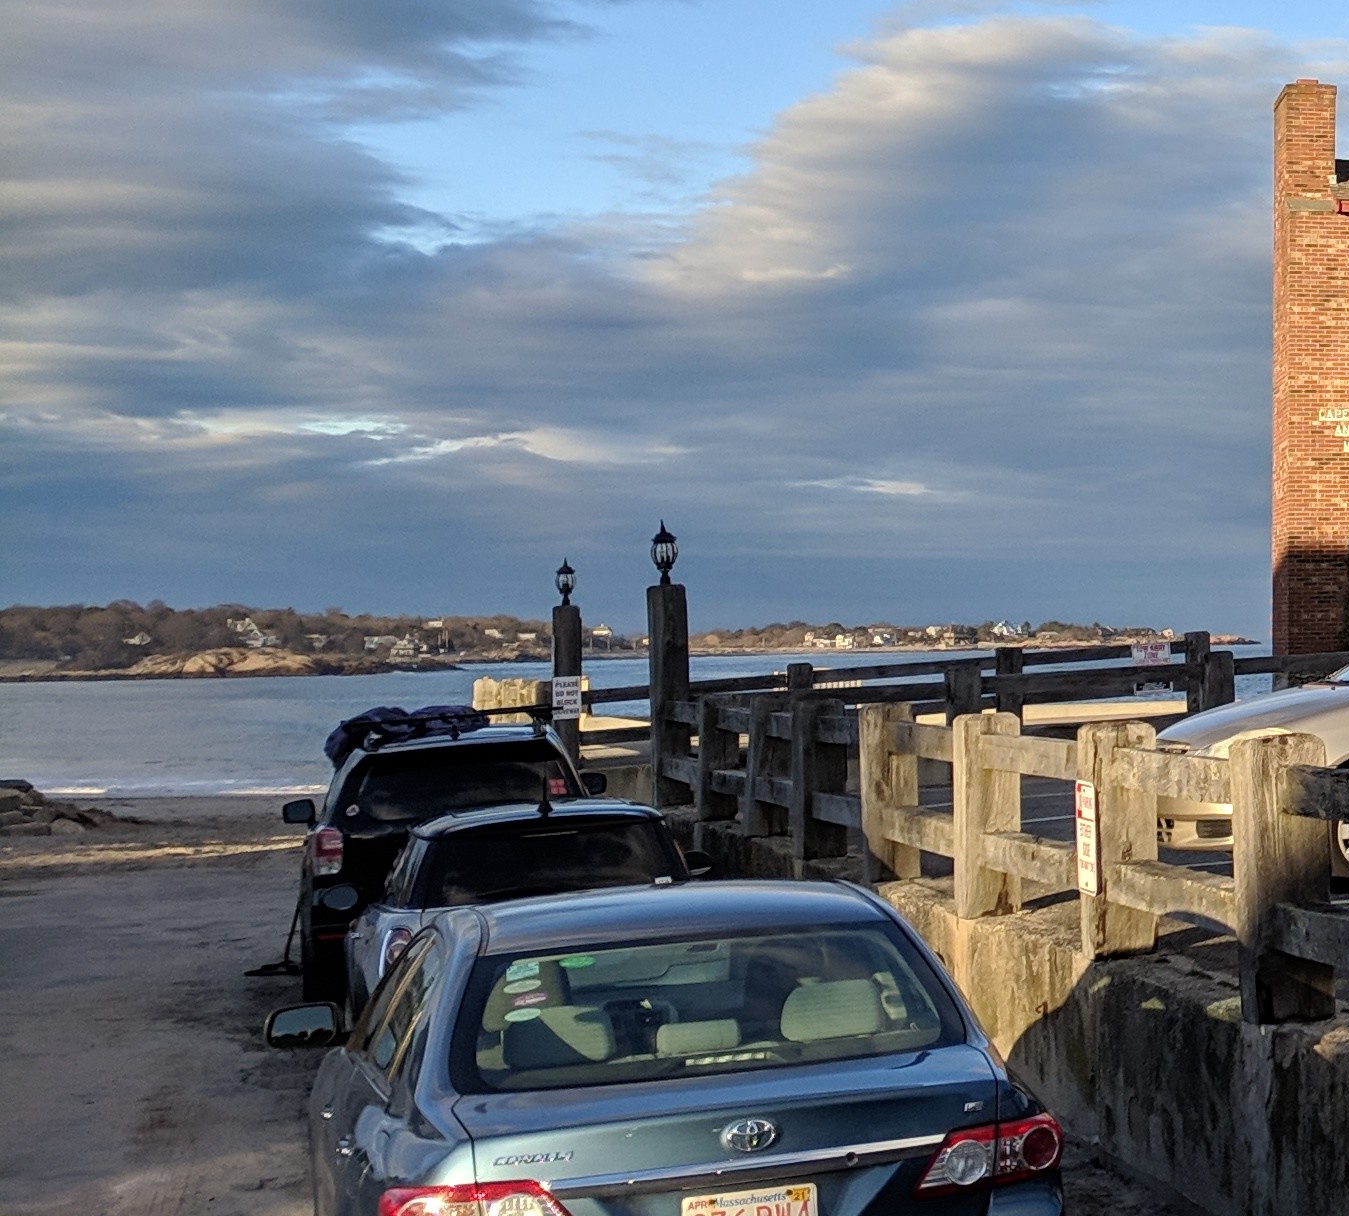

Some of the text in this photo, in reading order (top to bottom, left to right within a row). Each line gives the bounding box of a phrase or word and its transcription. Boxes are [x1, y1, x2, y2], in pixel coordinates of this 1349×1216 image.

[1318, 409, 1349, 421] CAPE
[555, 680, 578, 688] PLEASE
[493, 1150, 574, 1166] COROLLA
[688, 1200, 708, 1211] APR
[714, 1193, 787, 1209] Massachusetts
[793, 1191, 806, 1201] 21
